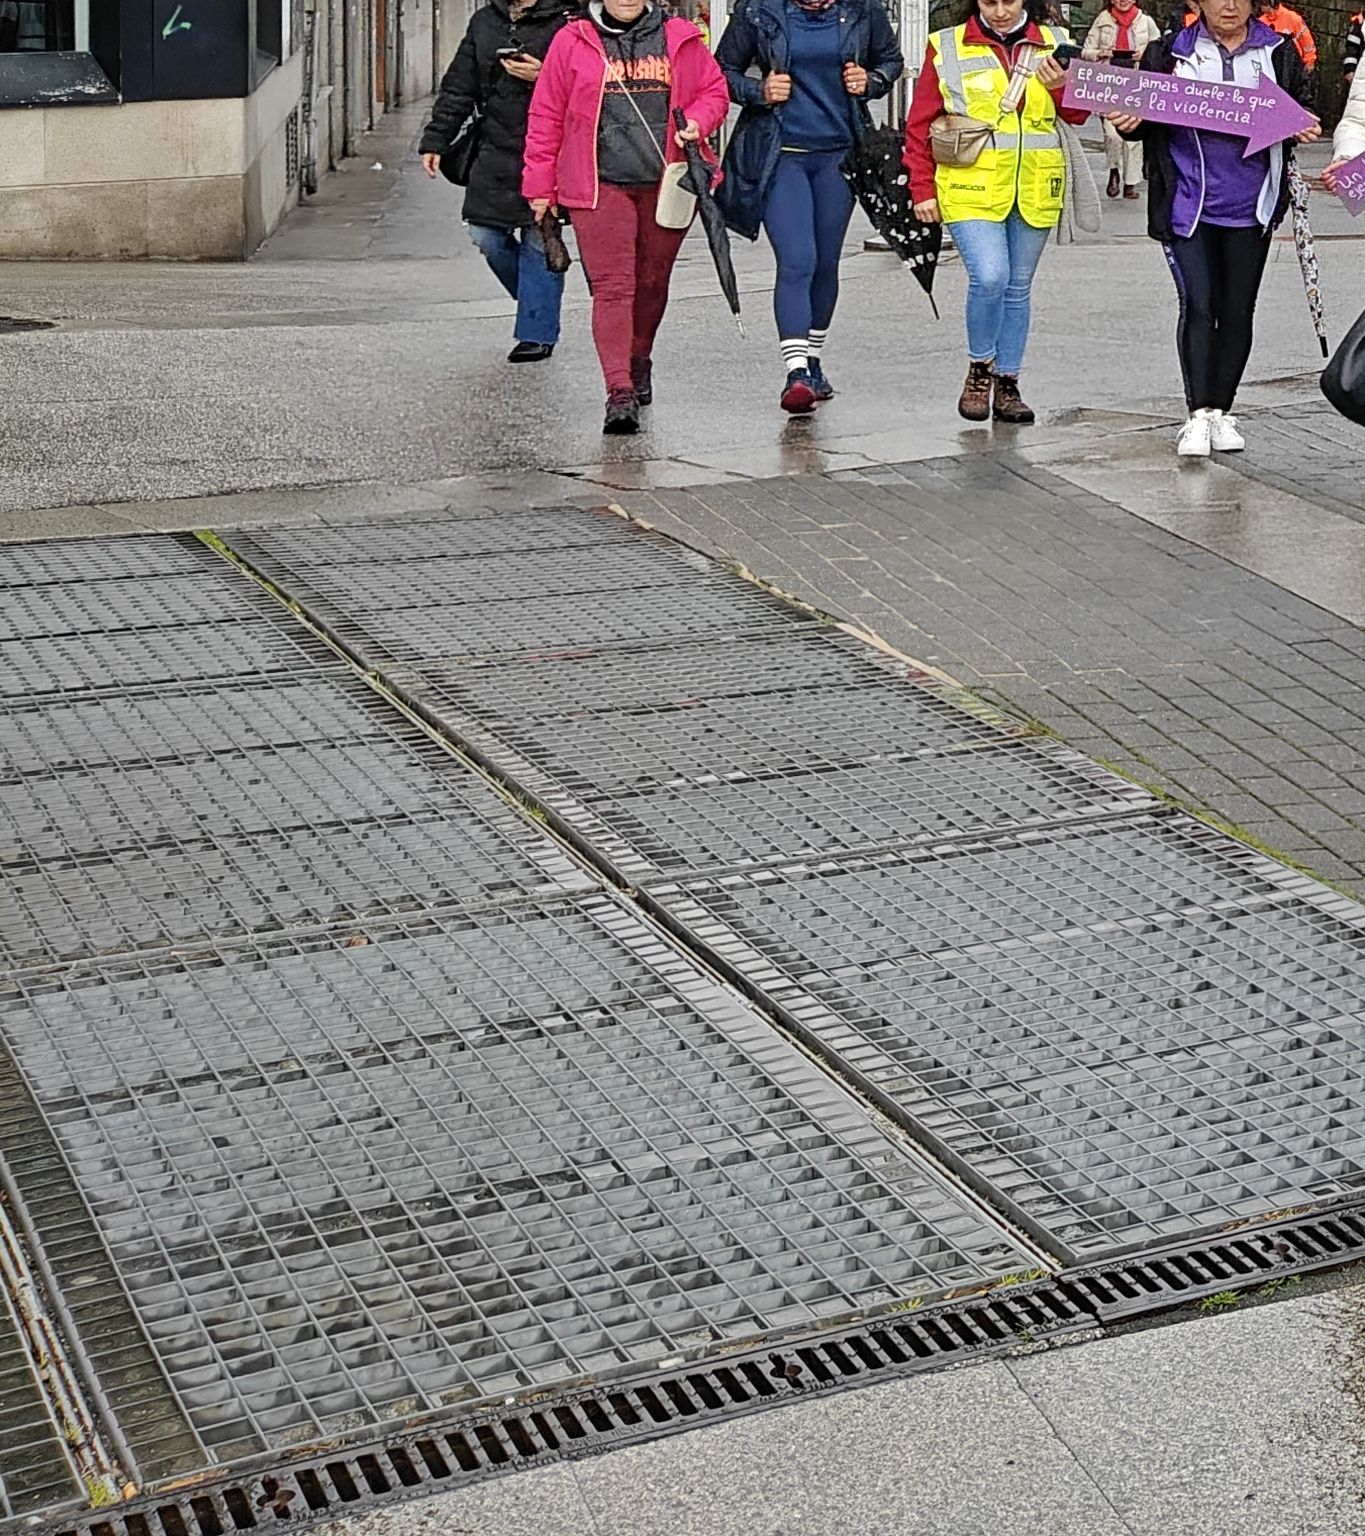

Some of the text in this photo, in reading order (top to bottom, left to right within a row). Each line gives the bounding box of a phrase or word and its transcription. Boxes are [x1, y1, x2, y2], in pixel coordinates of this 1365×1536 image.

[1074, 83, 1256, 126] duele es la violencia.
[1077, 67, 1093, 81] El
[1095, 72, 1130, 86] amor
[1249, 96, 1276, 112] que
[1335, 172, 1364, 189] Un
